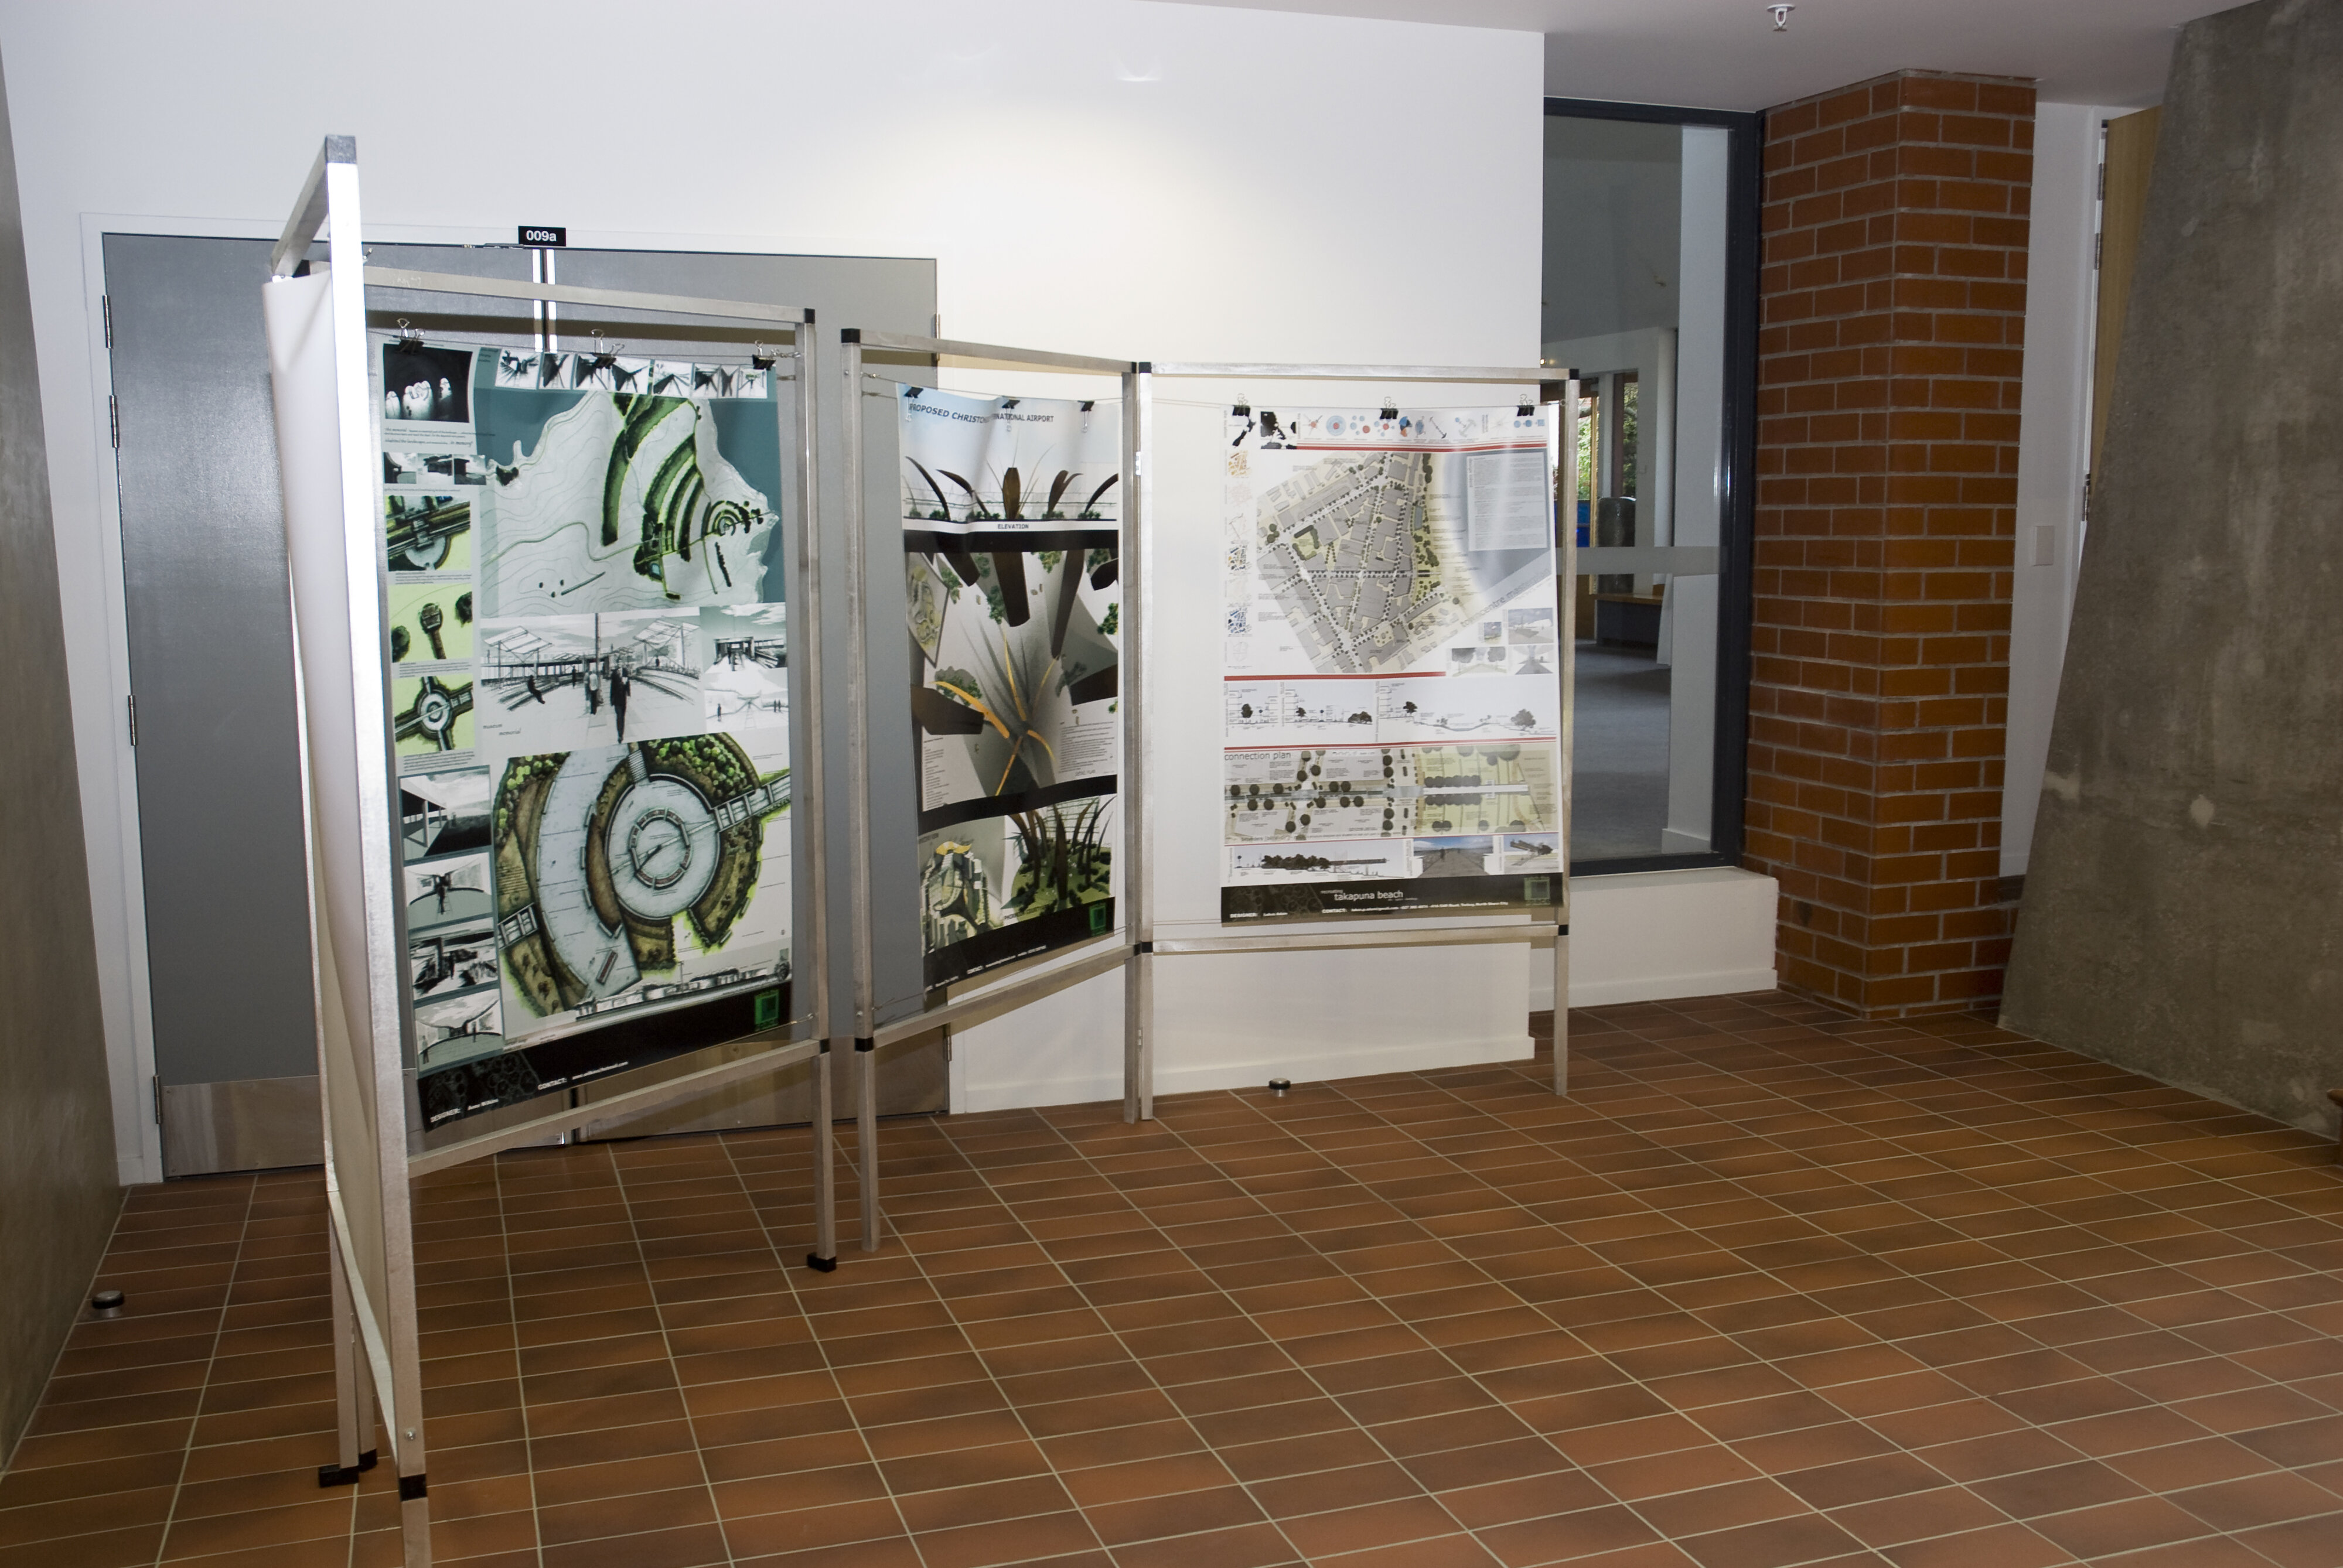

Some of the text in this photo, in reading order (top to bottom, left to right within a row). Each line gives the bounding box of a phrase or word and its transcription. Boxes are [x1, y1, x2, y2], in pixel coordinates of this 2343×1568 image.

[526, 230, 557, 241] 009a
[909, 403, 950, 418] PROPOSED
[1027, 414, 1054, 422] AIRPORT
[1224, 751, 1291, 761] connection plan
[1334, 890, 1404, 901] takapuna beach
[538, 1077, 568, 1091] CONTACT:
[430, 1107, 461, 1123] DESIGNER:
